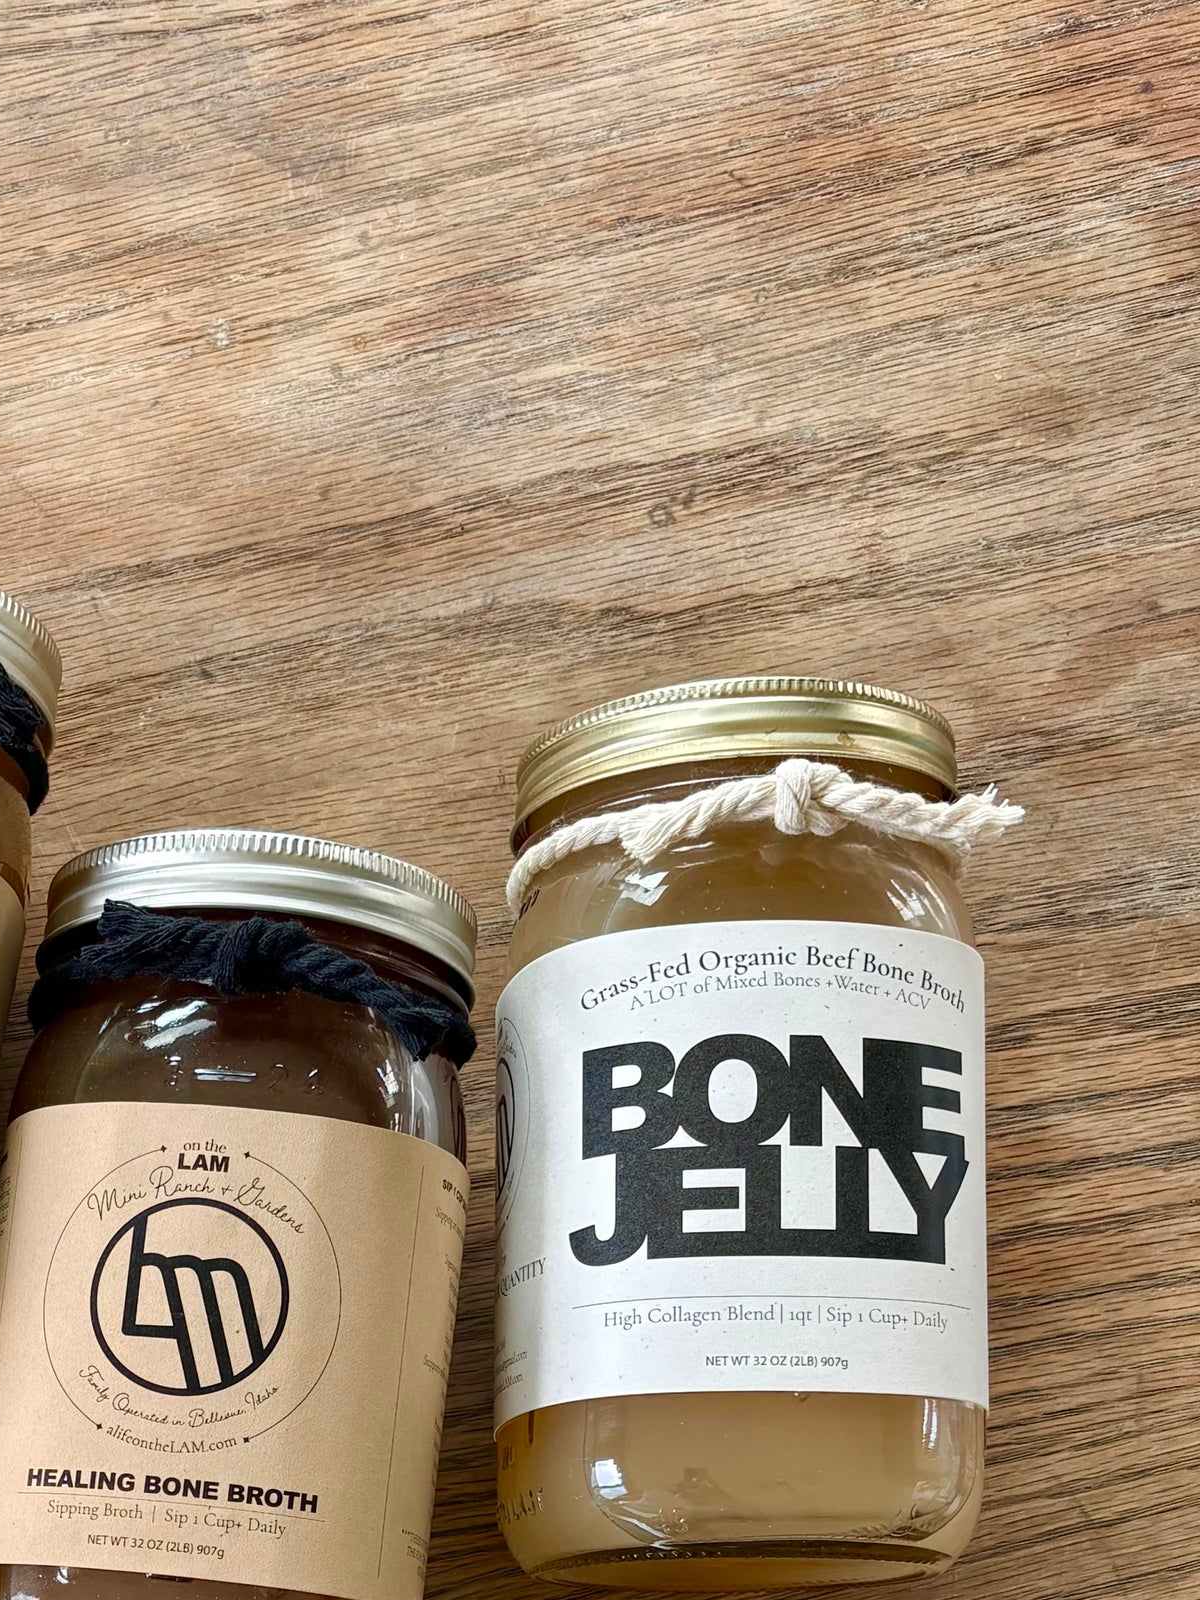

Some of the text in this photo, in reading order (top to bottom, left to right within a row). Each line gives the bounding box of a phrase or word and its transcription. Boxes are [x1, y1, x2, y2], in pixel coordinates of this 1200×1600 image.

[580, 946, 966, 1013] Grass-Fed Organic Beef Bone Broth
[630, 995, 644, 1010] A
[648, 982, 688, 1003] LOT
[693, 976, 712, 994] of
[716, 973, 767, 991] Mixed
[774, 972, 820, 989] Bones
[895, 989, 932, 1011] ACV
[582, 1033, 965, 1160] BONE
[177, 1153, 230, 1173] LAM
[183, 1139, 227, 1153] on the
[87, 1185, 147, 1220] Mini
[150, 1165, 215, 1200] Ranch
[233, 1177, 305, 1234] Gardens
[569, 1144, 969, 1266] JELLY
[604, 1304, 949, 1333] High Collagen Blend 1qt Sip 1 Cup+ Daily
[705, 1355, 849, 1370] NET WT 32 OZ (2LB) 907g
[79, 1365, 111, 1402] Family
[112, 1392, 168, 1425] Operated
[171, 1416, 185, 1426] in
[244, 1386, 279, 1410] Idaho
[106, 1424, 238, 1454] alifeontheLAM.com
[26, 1468, 319, 1513] HEALING BONE BROTH
[47, 1500, 287, 1540] Sipping Broth Sip 1 Cup+ Daily
[87, 1534, 226, 1560] NET WT 32 OZ (2LB) 907g
